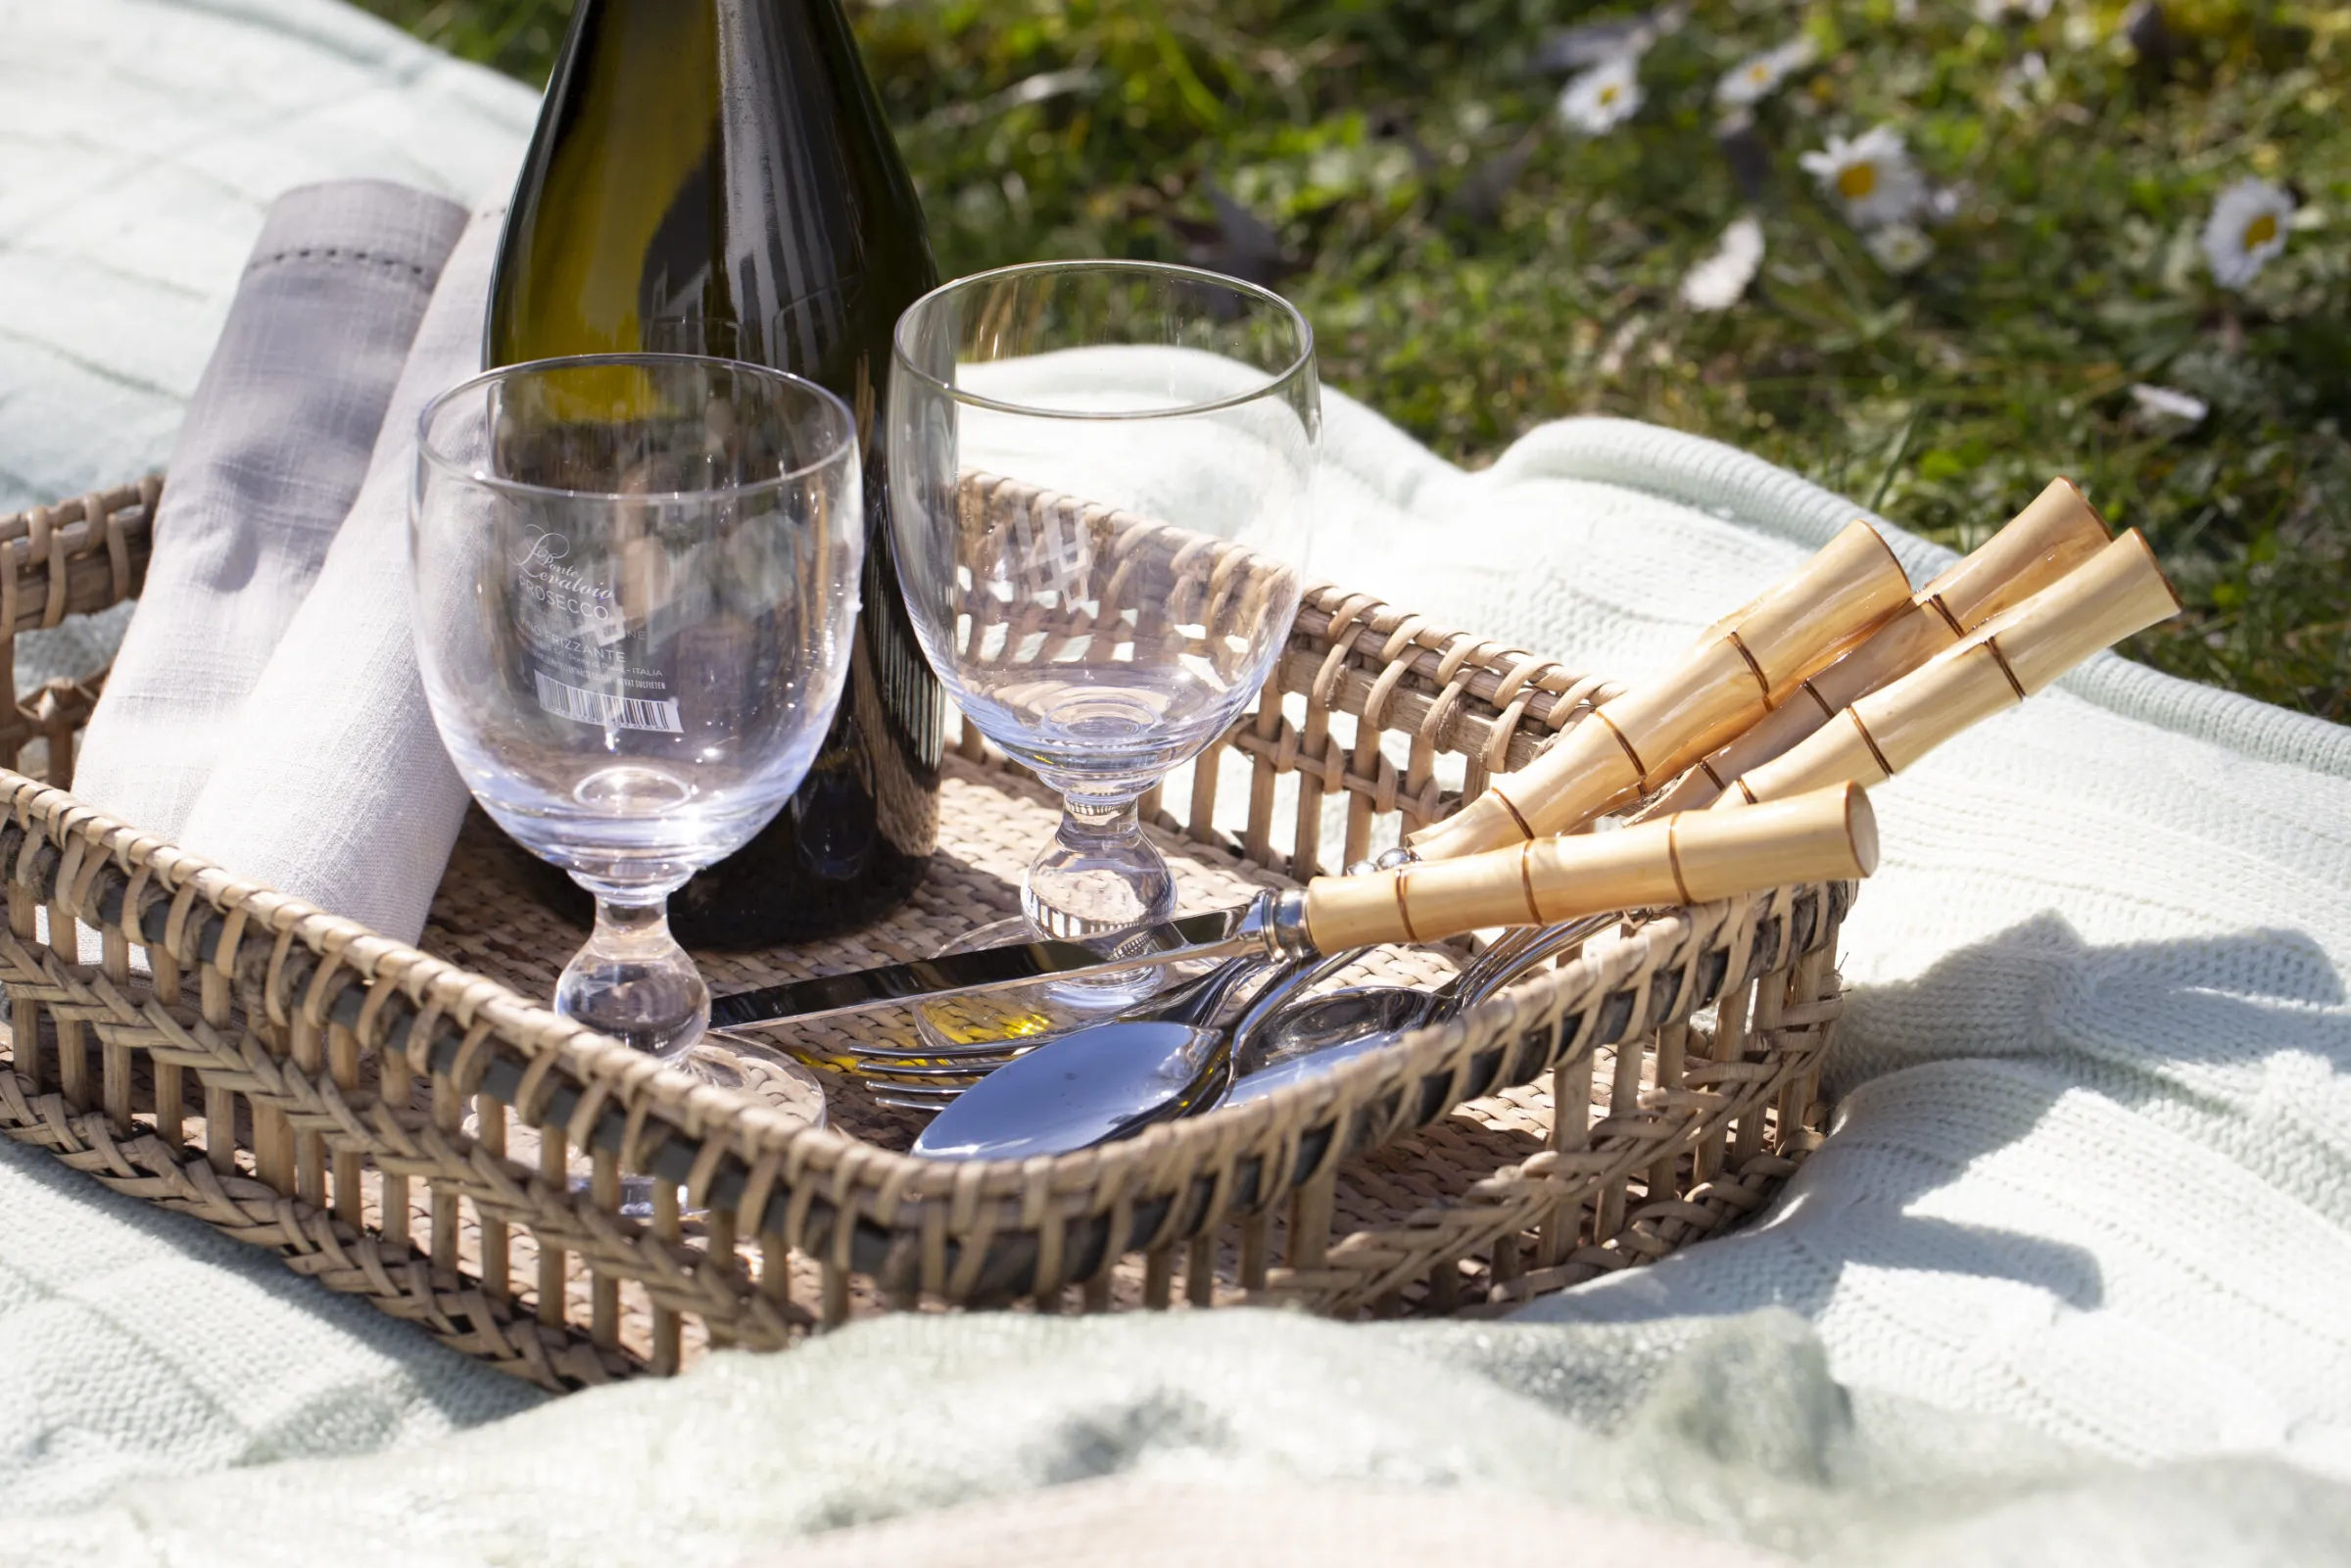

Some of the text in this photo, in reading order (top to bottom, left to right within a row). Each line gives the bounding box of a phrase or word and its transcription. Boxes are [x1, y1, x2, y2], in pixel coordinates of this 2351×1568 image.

[536, 546, 579, 577] Ponte
[519, 575, 609, 620] PROSECCO
[545, 631, 626, 663] FRIZZANTE
[632, 667, 663, 677] ITALIA
[635, 680, 666, 689] SULFIETEN
